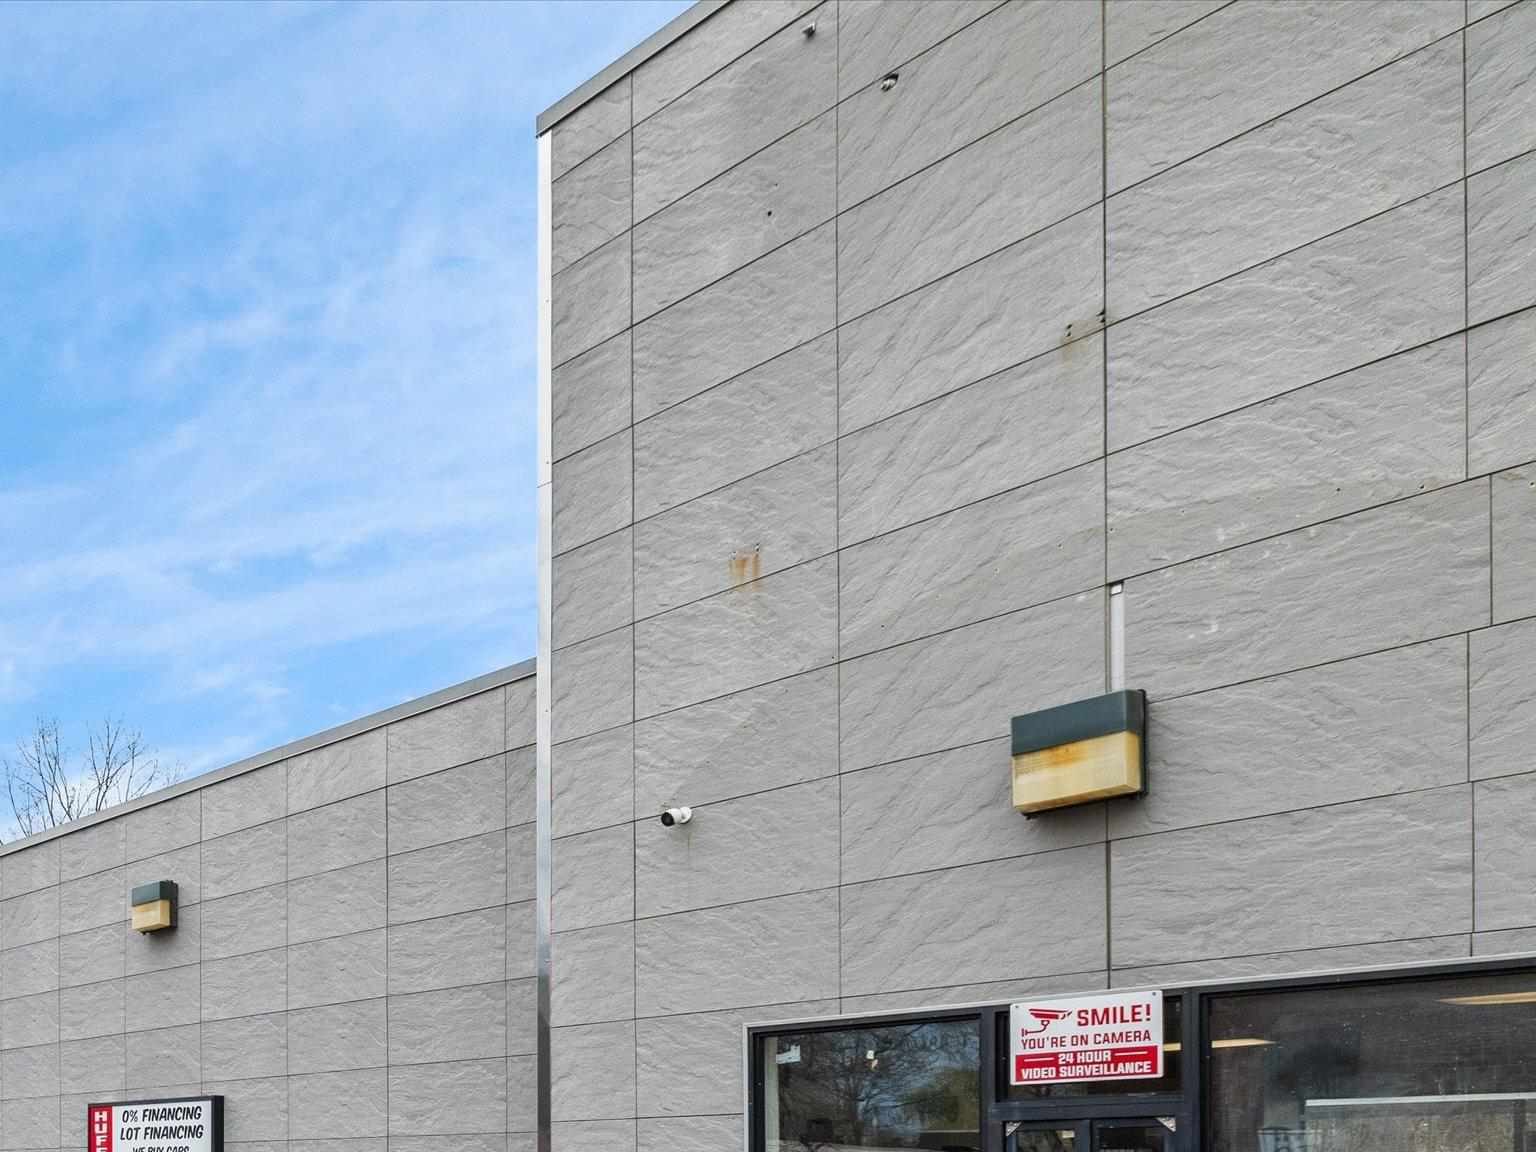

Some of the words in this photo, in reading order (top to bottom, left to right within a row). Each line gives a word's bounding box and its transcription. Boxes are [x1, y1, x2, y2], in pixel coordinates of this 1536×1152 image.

[1076, 1003, 1151, 1027] SMILE!
[1021, 1035, 1066, 1050] YOU'RE
[1071, 1034, 1089, 1047] ON
[1093, 1029, 1152, 1045] CAMERA
[1058, 1053, 1075, 1065] 24
[1076, 1050, 1112, 1063] HOUR
[1021, 1066, 1056, 1080] VIDEO
[1059, 1061, 1152, 1077] SURVEILLANCE
[122, 1109, 139, 1123] 0%
[141, 1106, 202, 1122] FINANCING
[120, 1127, 141, 1140] LOT
[143, 1124, 204, 1140] FINANCING
